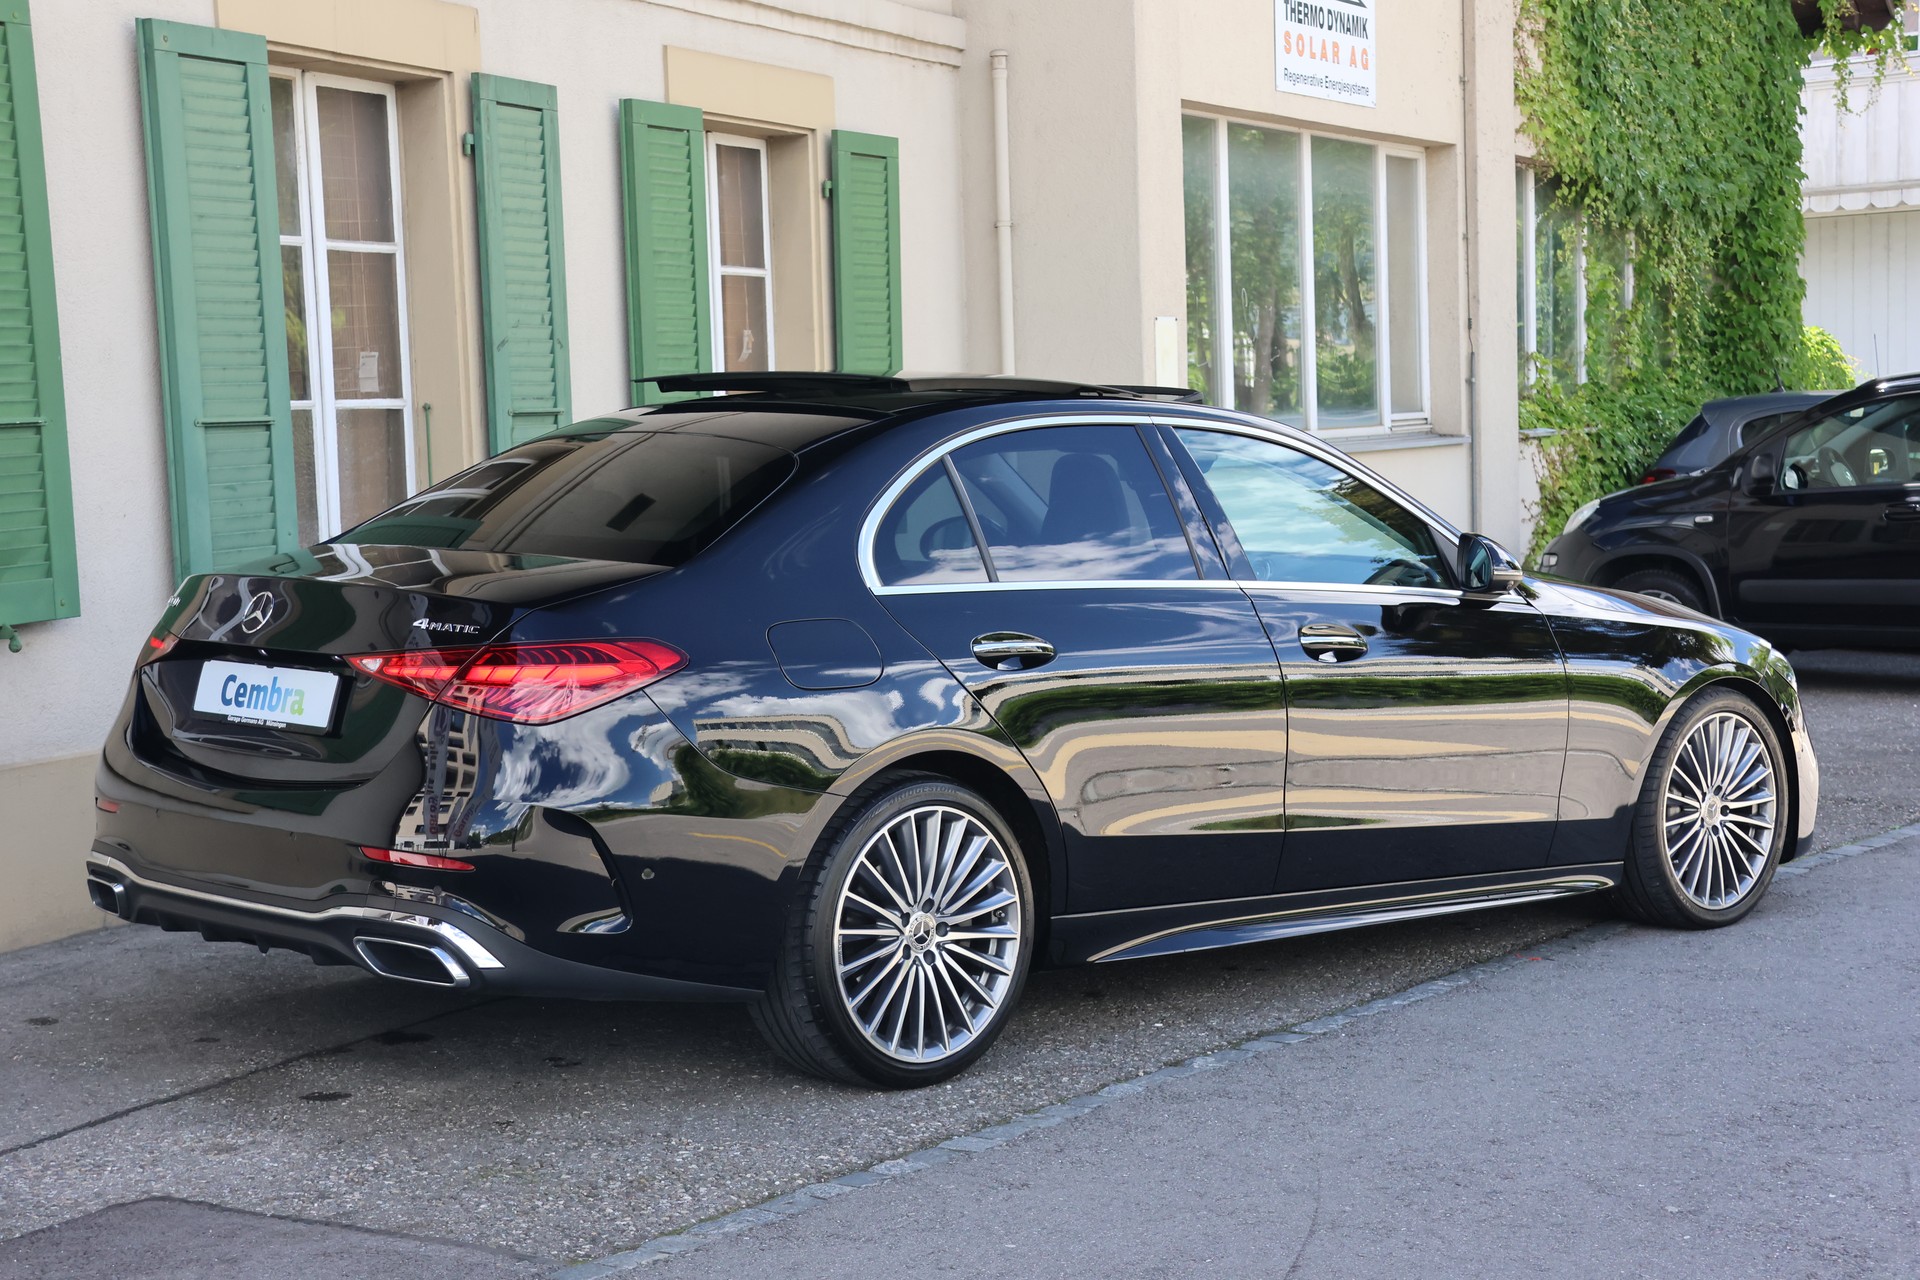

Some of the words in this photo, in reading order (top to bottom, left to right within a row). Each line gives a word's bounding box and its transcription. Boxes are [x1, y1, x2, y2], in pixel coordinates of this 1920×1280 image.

[1284, 0, 1325, 29] THERMO
[1327, 8, 1369, 40] DYNAMIK
[1284, 30, 1340, 65] SOLAR
[1349, 45, 1369, 70] AG
[1283, 67, 1324, 88] Regenerative
[1325, 75, 1370, 97] Energiesysteme
[412, 618, 480, 634] 4MATIC
[220, 673, 305, 716] Cembra
